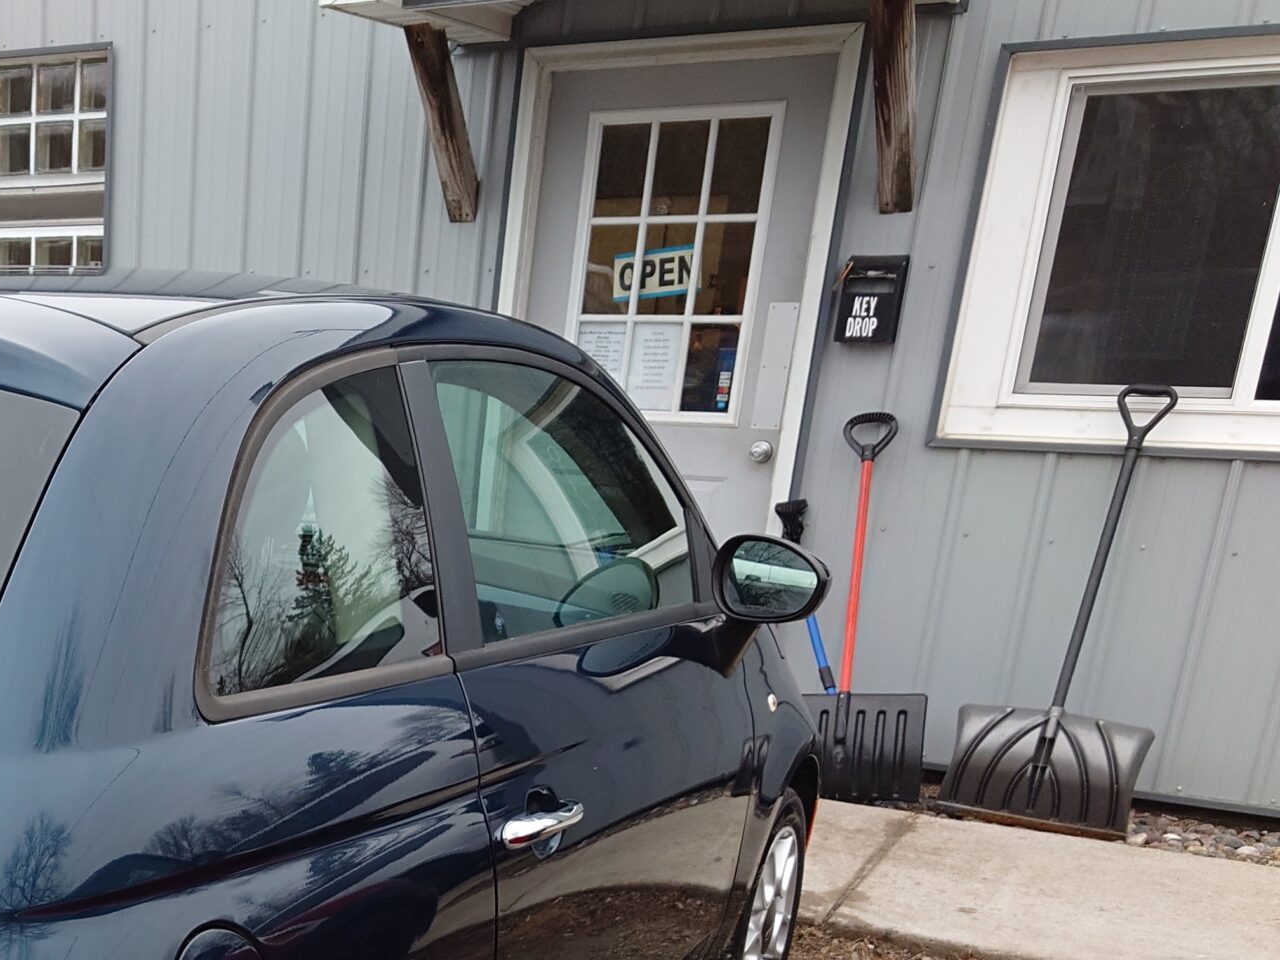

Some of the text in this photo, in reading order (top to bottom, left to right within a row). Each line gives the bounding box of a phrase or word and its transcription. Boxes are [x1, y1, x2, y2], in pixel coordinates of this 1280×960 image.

[619, 254, 696, 291] OPEN
[852, 296, 878, 316] KEY
[845, 317, 878, 337] DROP
